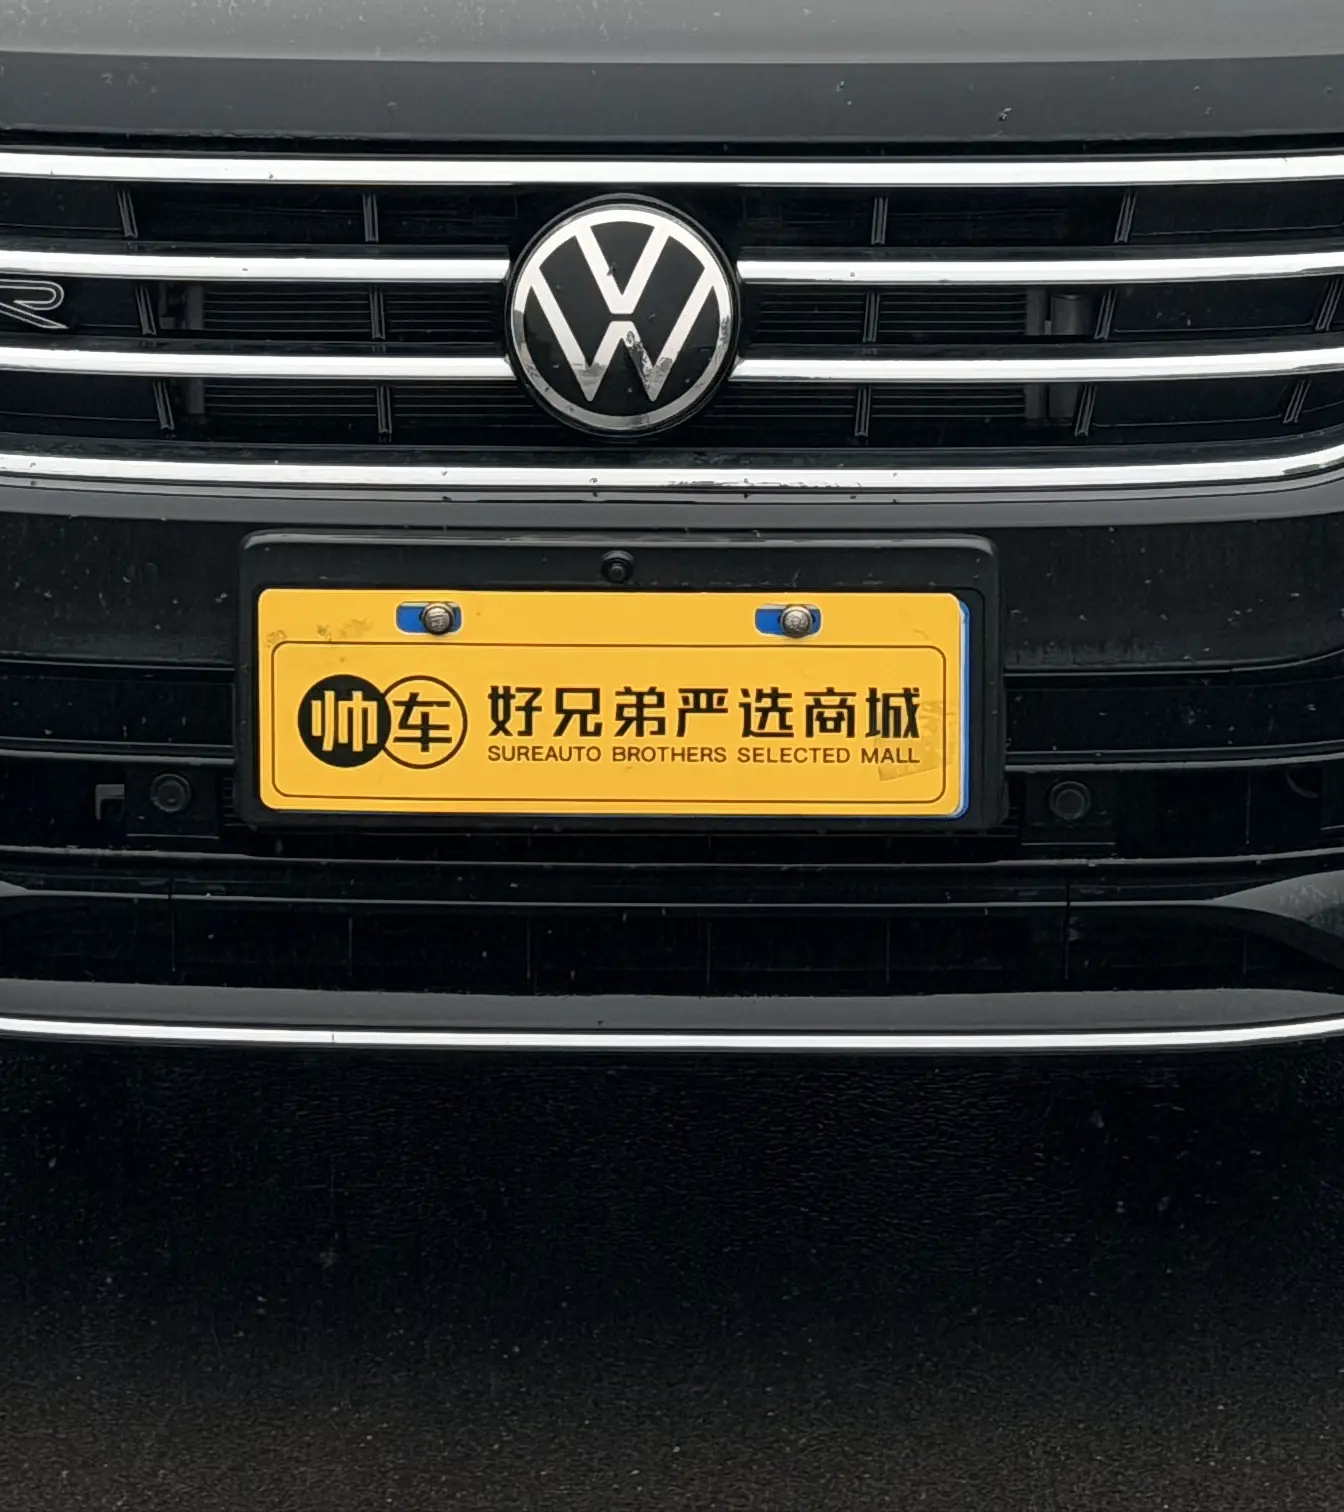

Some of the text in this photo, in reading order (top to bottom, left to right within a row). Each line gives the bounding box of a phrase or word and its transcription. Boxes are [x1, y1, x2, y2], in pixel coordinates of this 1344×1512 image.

[512, 205, 731, 420] VW
[310, 689, 453, 753] 帅车
[487, 684, 921, 738] 好兄弟严选商城
[487, 745, 921, 764] SUREAUTO BROTHERS SELECTED MALL
